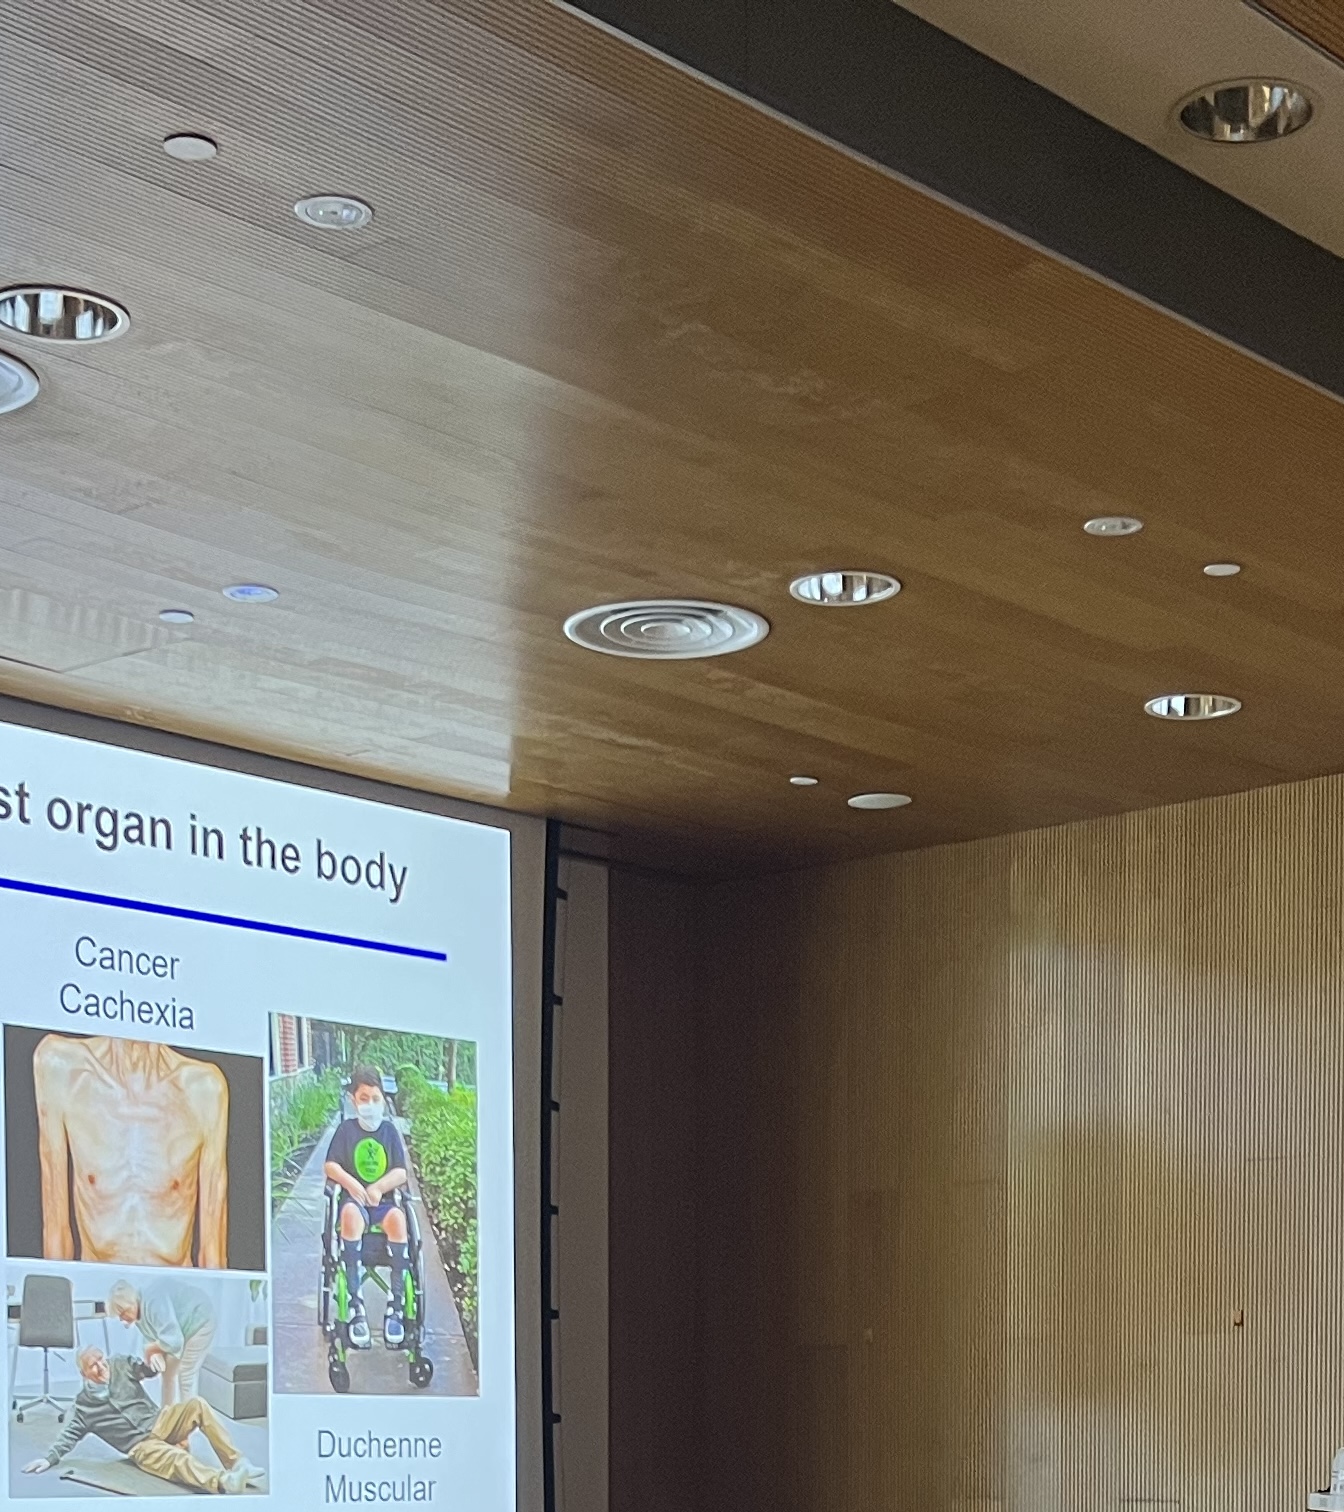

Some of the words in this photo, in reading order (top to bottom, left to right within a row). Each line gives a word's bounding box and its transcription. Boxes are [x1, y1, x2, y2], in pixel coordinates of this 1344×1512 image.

[46, 796, 173, 852] organ
[189, 812, 224, 861] in
[238, 825, 302, 875] the
[315, 838, 408, 905] body
[75, 935, 181, 981] Cancer
[59, 982, 195, 1031] Cachexia
[317, 1429, 442, 1459] Duchenne
[325, 1473, 437, 1504] Muscular
